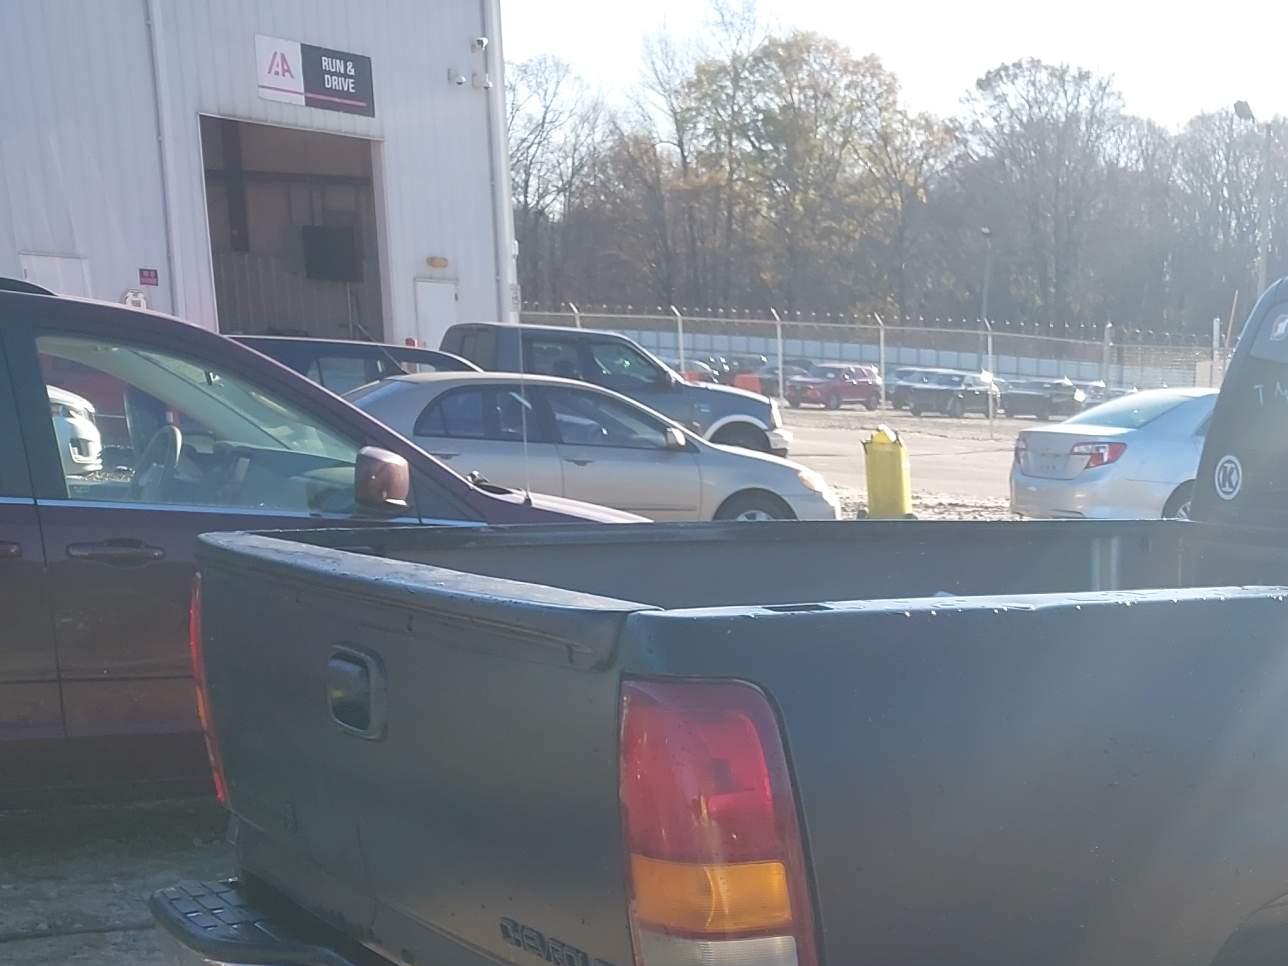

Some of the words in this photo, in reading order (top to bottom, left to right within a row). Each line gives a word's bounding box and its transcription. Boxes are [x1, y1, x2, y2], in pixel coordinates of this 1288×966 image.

[321, 56, 344, 74] RUN
[346, 61, 355, 76] &
[324, 74, 356, 93] DRIVE
